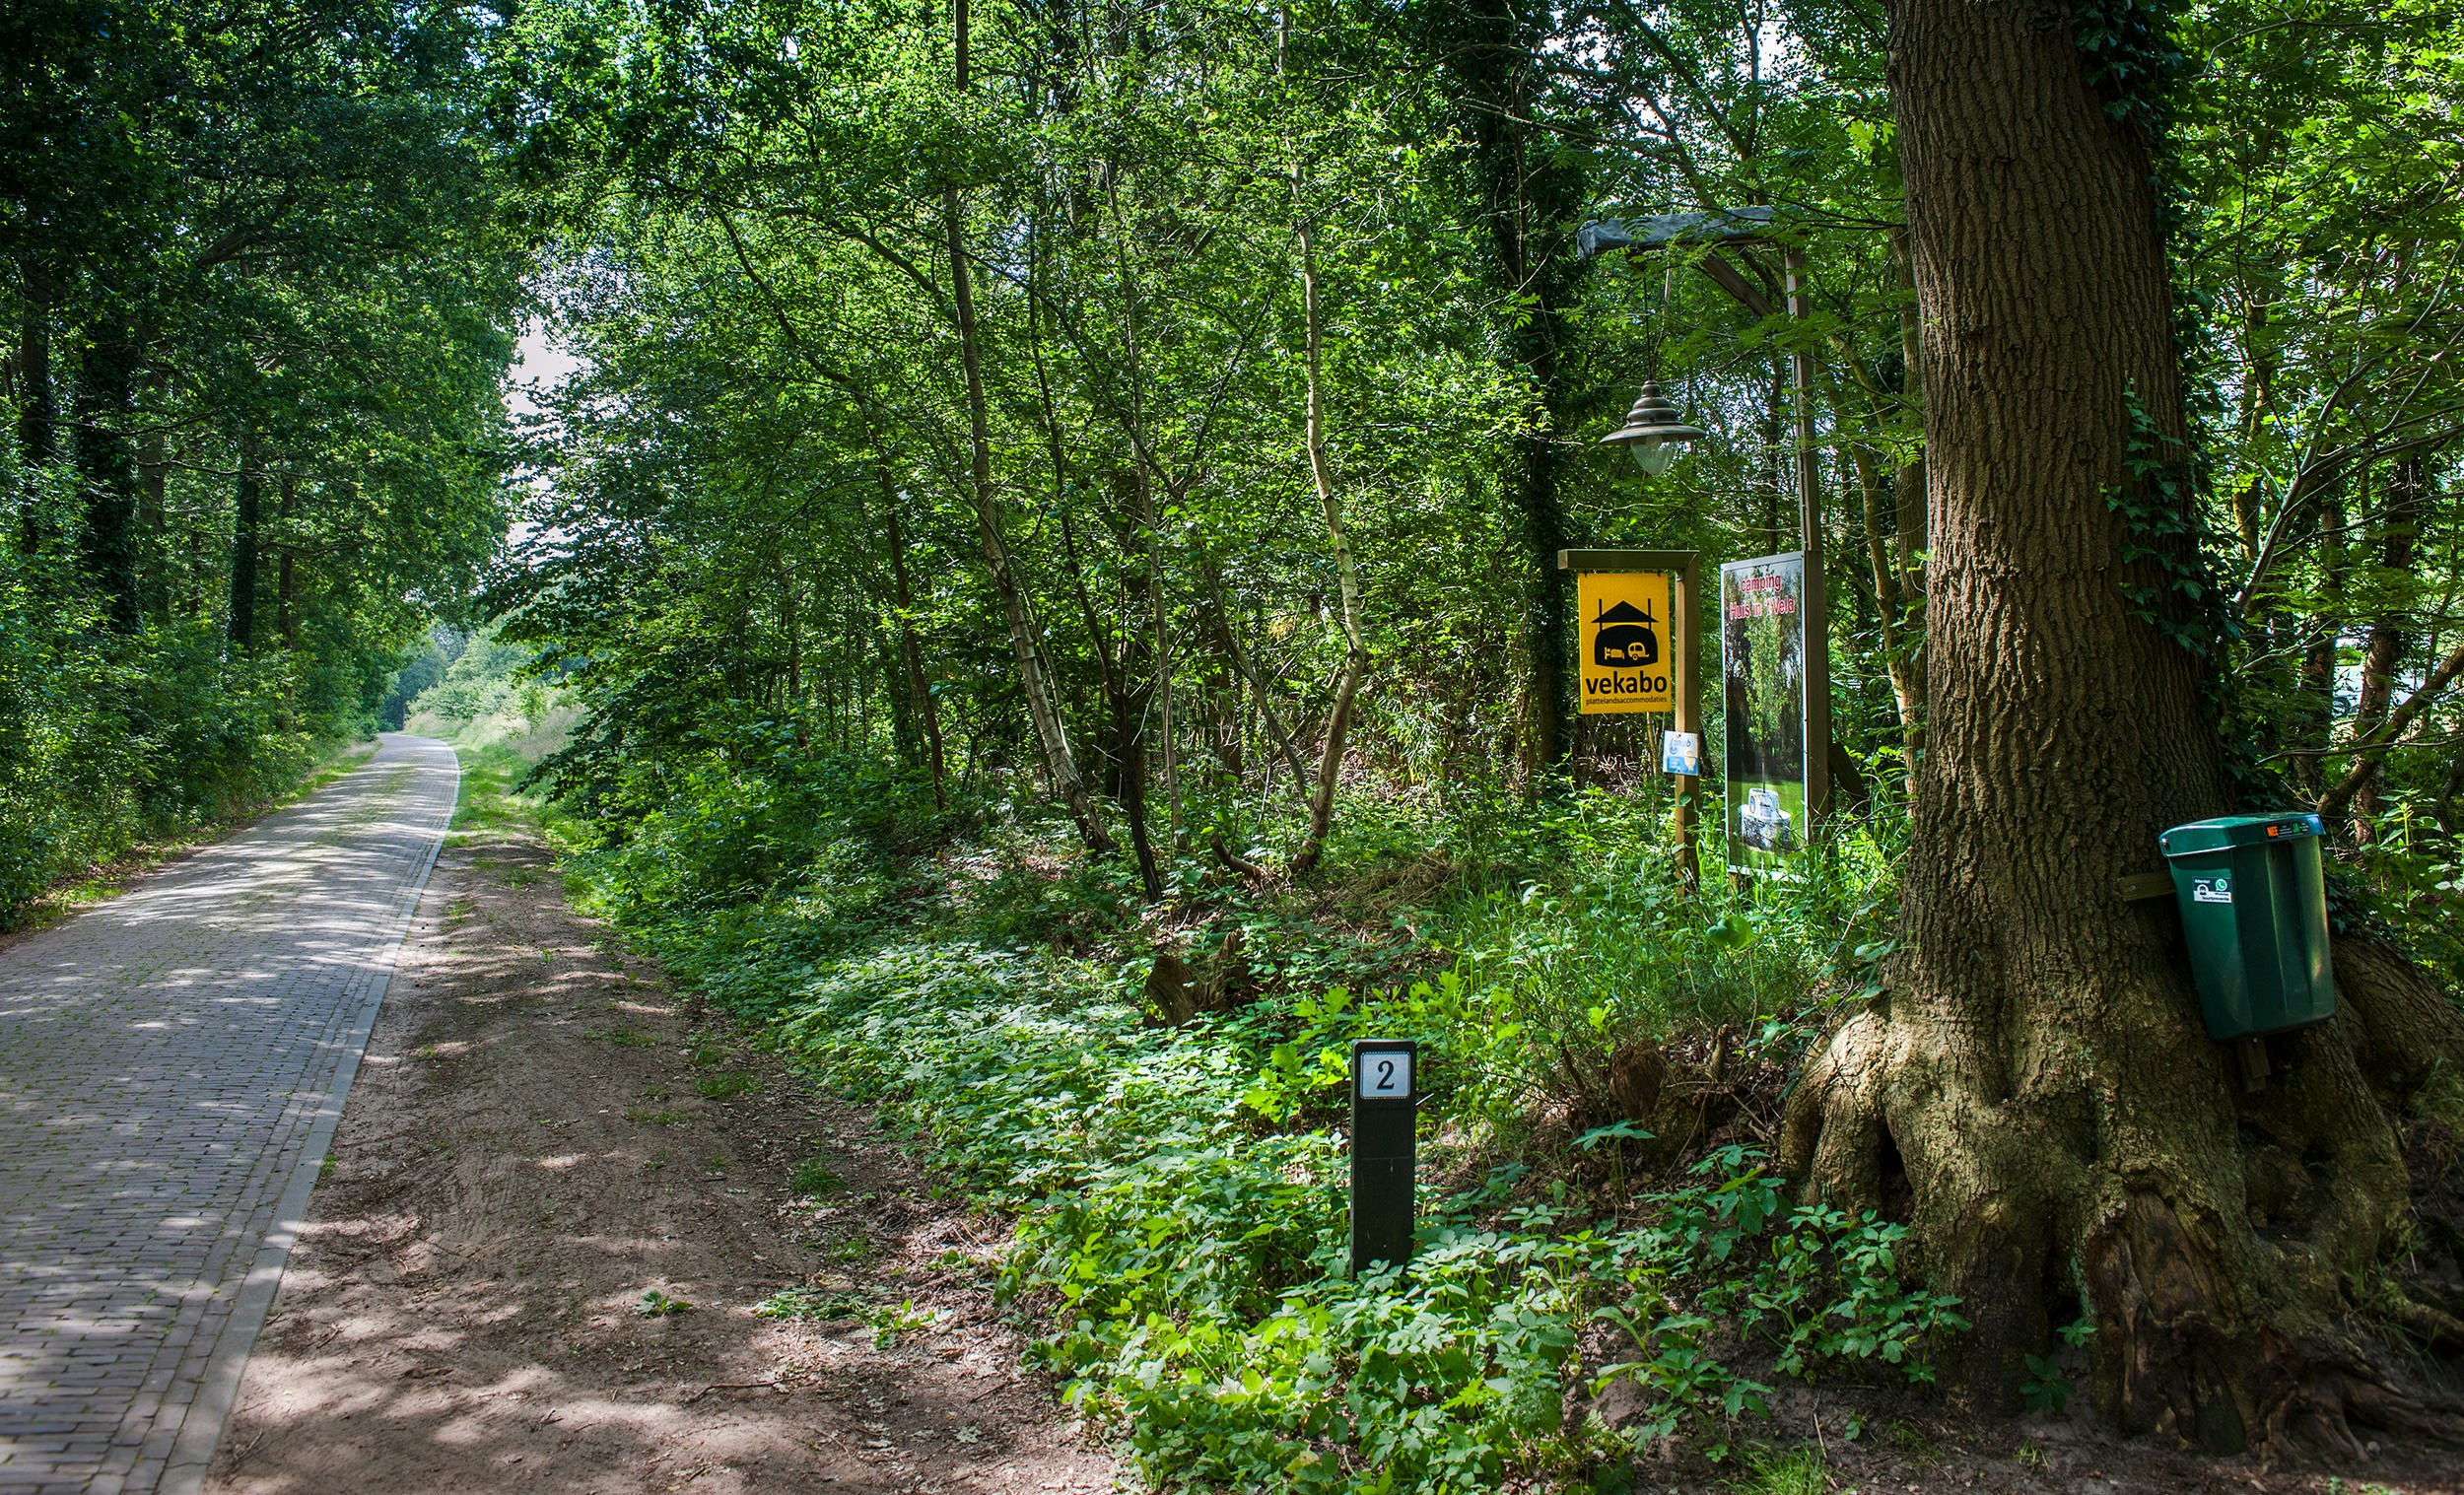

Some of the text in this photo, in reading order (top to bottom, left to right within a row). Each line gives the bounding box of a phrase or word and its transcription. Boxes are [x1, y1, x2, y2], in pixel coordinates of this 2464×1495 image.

[1741, 574, 1781, 593] camping
[1730, 602, 1750, 620] Huis
[1752, 602, 1762, 617] in
[1772, 595, 1794, 615] Veld
[1585, 670, 1668, 695] vekabo
[1586, 696, 1667, 706] plattelandsaccommodaties
[1377, 1059, 1395, 1090] 2
